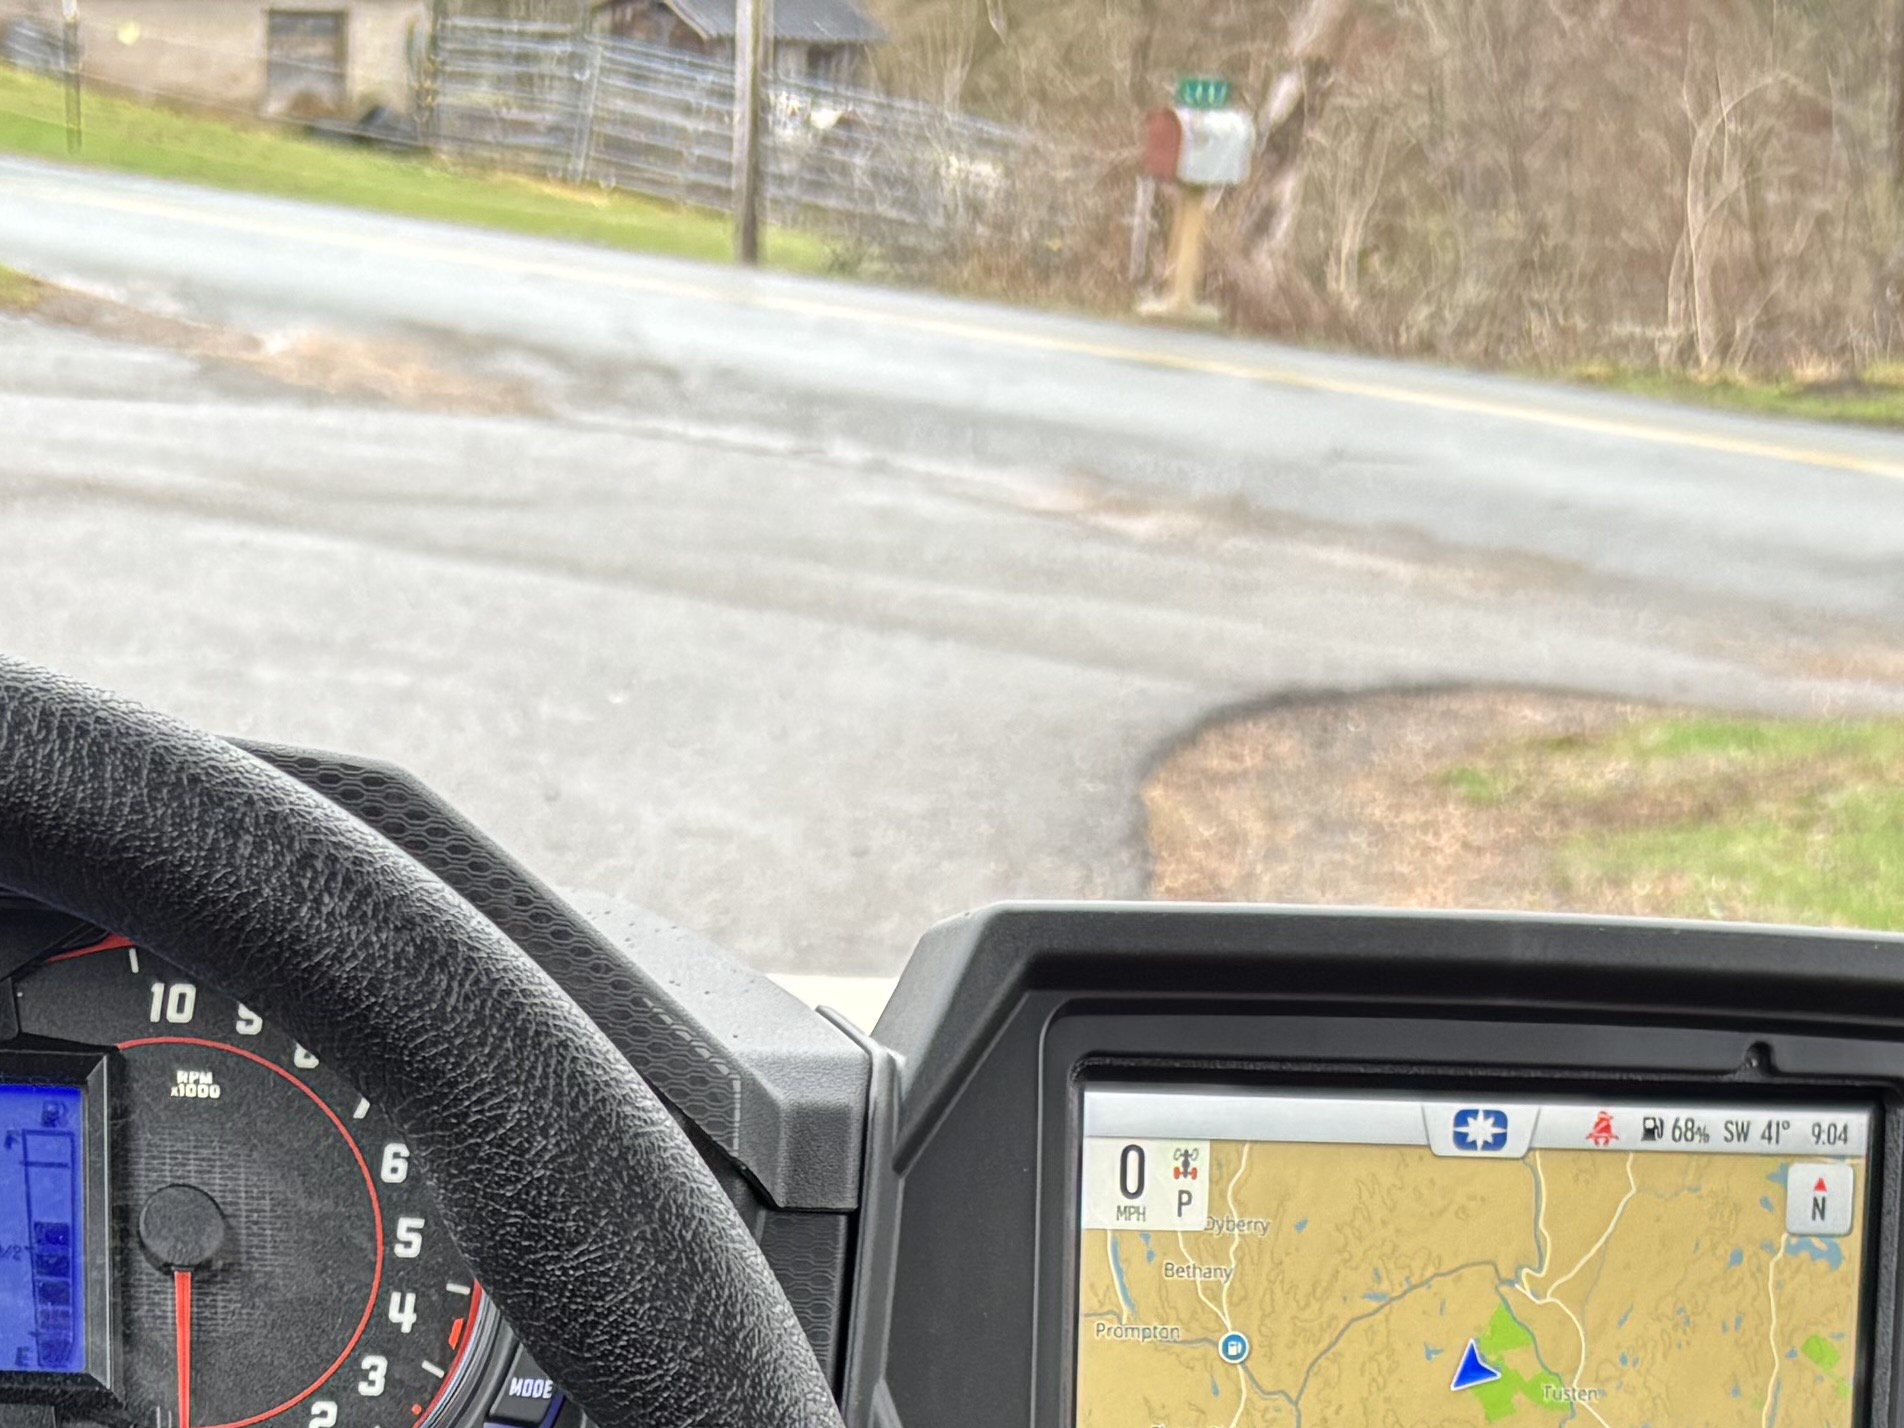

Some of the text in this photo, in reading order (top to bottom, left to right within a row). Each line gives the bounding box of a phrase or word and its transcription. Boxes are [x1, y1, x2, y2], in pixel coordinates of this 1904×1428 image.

[150, 982, 197, 1024] 10
[176, 1070, 214, 1085] RPM
[170, 1083, 221, 1099] x1000
[1671, 1117, 1849, 1146] 68% SW 41° 9:04
[381, 1143, 410, 1184] 6
[1119, 1144, 1146, 1200] 0
[1116, 1205, 1146, 1222] MPH
[1177, 1190, 1193, 1218] P
[1811, 1196, 1827, 1221] N
[394, 1217, 425, 1258] 5
[1206, 1216, 1271, 1236] Dyberry
[1164, 1262, 1234, 1284] Bethany
[387, 1292, 418, 1333] 4
[1096, 1322, 1180, 1341] Prompton
[359, 1356, 388, 1396] 3
[508, 1377, 554, 1399] MODE
[1544, 1385, 1598, 1401] Tusten
